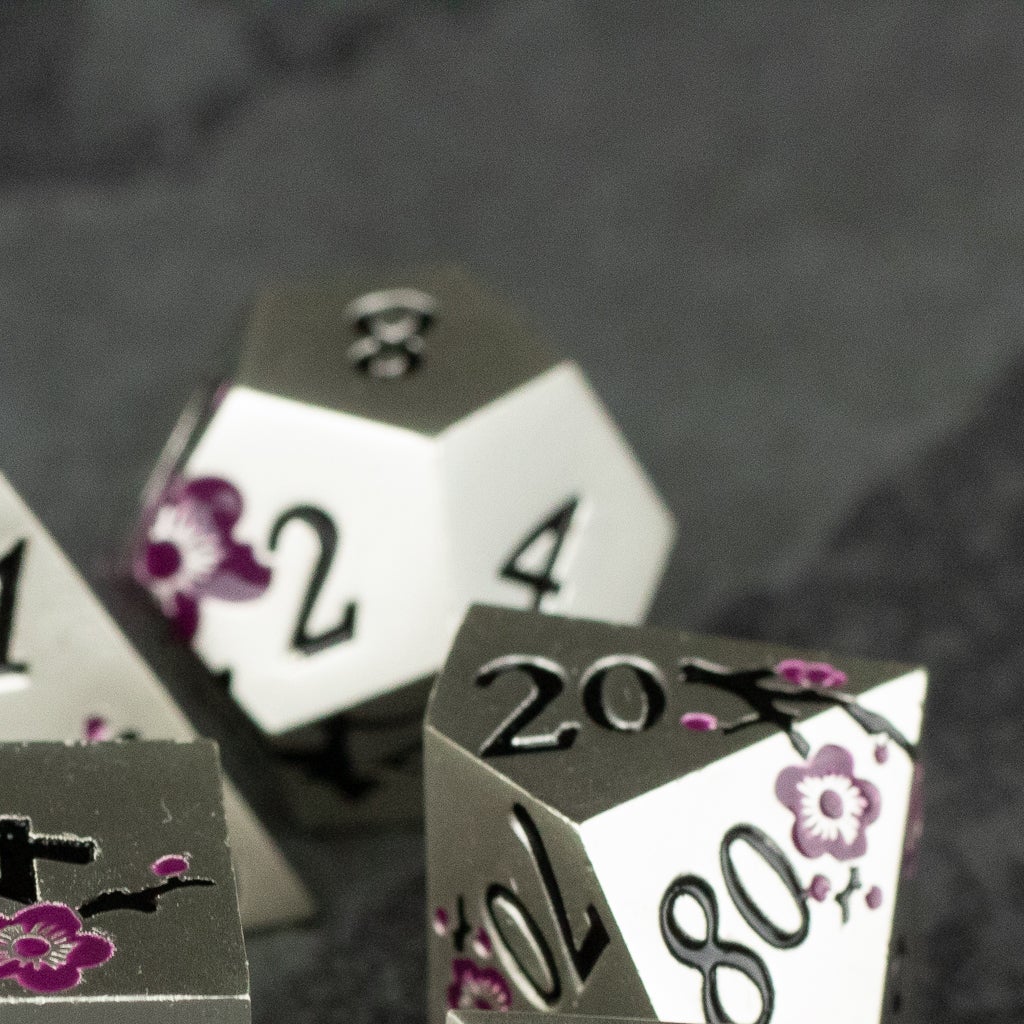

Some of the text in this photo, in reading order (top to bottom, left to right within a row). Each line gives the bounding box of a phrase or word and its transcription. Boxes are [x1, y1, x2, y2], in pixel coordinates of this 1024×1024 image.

[345, 287, 439, 379] 8
[267, 502, 360, 657] 2
[496, 492, 582, 615] 4
[475, 653, 668, 759] 20
[480, 801, 611, 1011] 70
